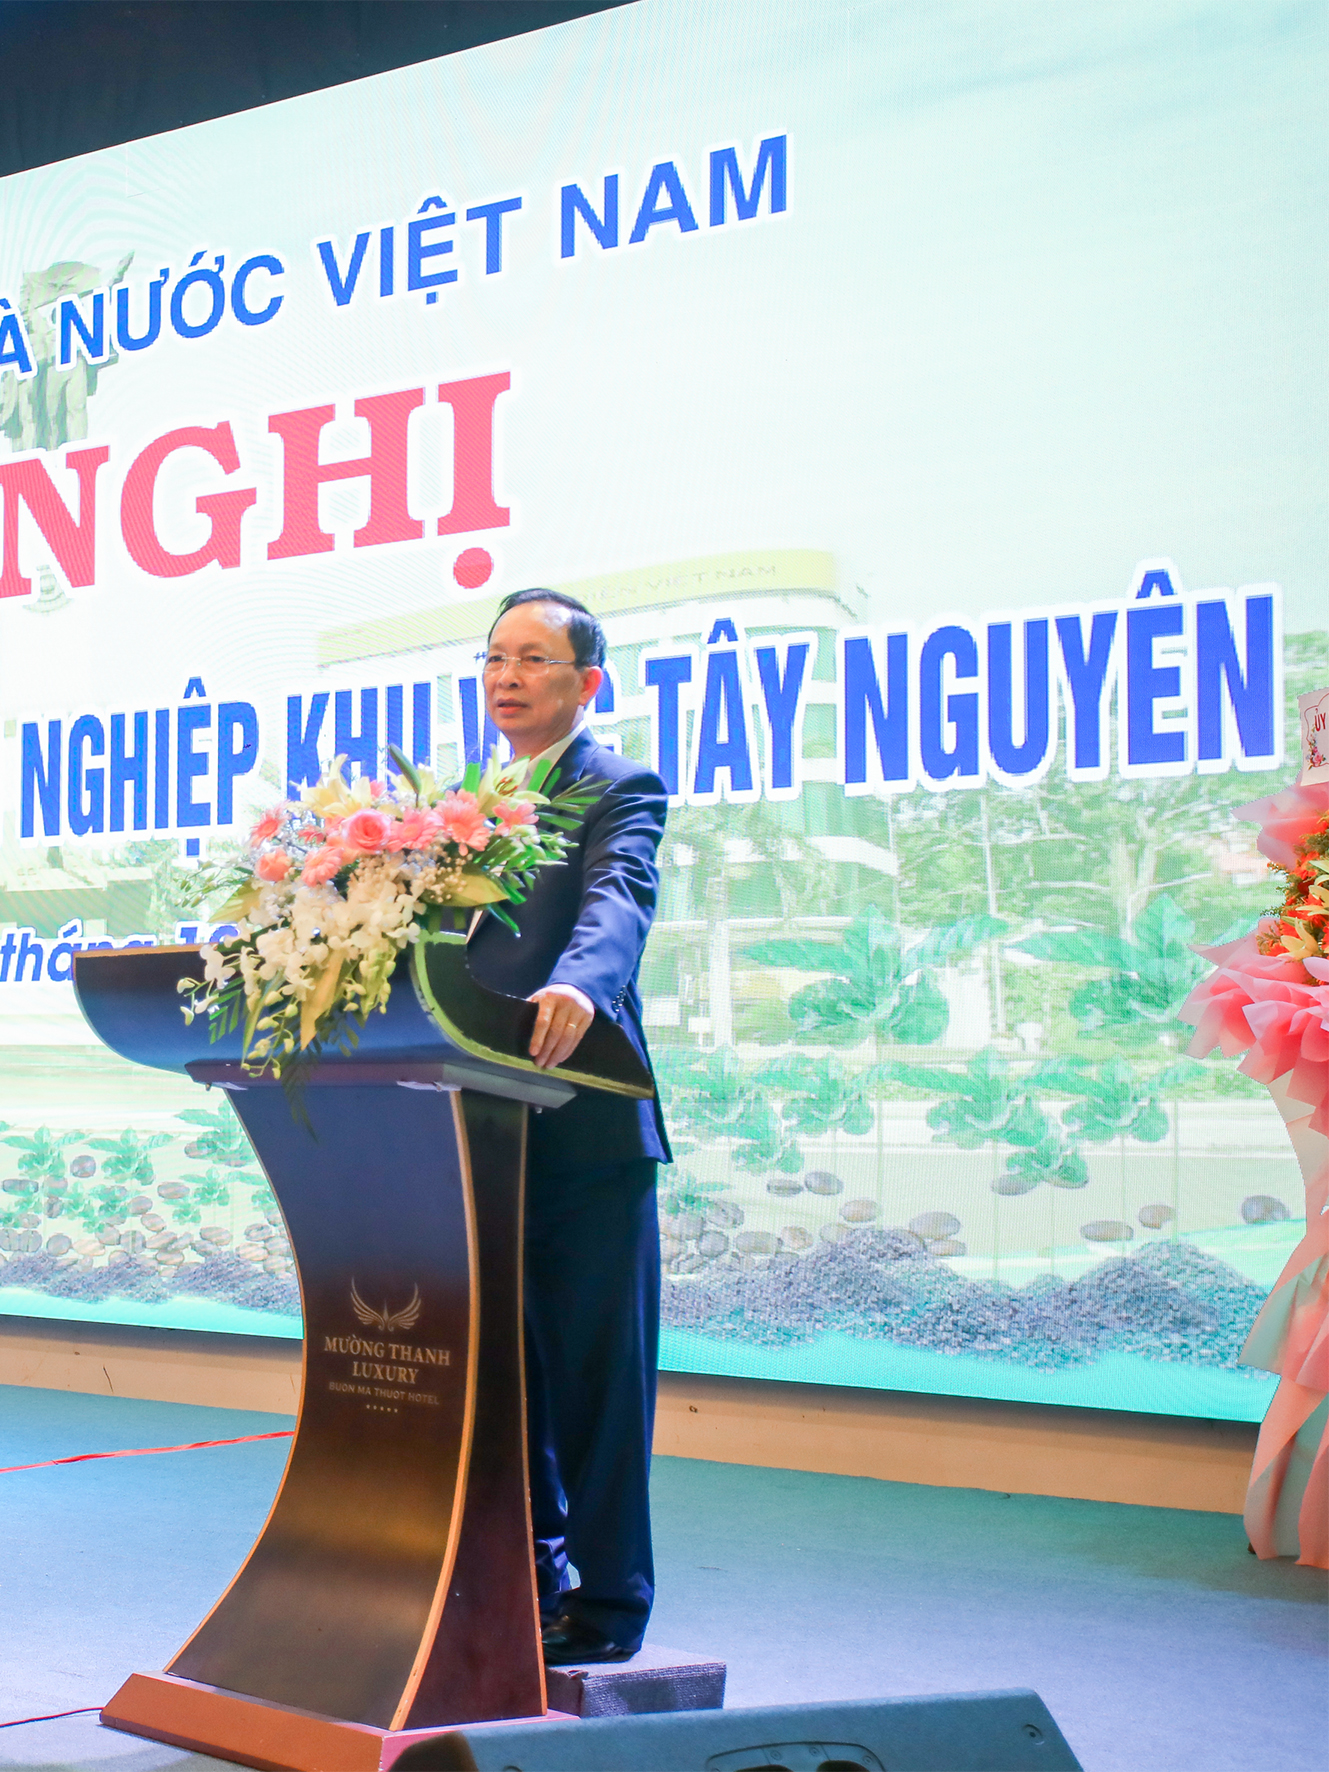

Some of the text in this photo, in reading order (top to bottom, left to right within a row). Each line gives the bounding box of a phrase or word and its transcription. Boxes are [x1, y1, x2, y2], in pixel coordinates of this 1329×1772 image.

[60, 249, 285, 365] NƯỚC
[316, 195, 522, 307] VIỆT
[560, 134, 788, 259] NAM
[20, 676, 261, 857] NGHIỆP
[644, 617, 810, 796] TÂY
[844, 568, 1275, 784] NGUYÊN
[324, 1334, 451, 1366] MƯỜNG THANH
[352, 1361, 419, 1385] LUXURY
[329, 1381, 440, 1405] BUON MA THUOT HOTEL
